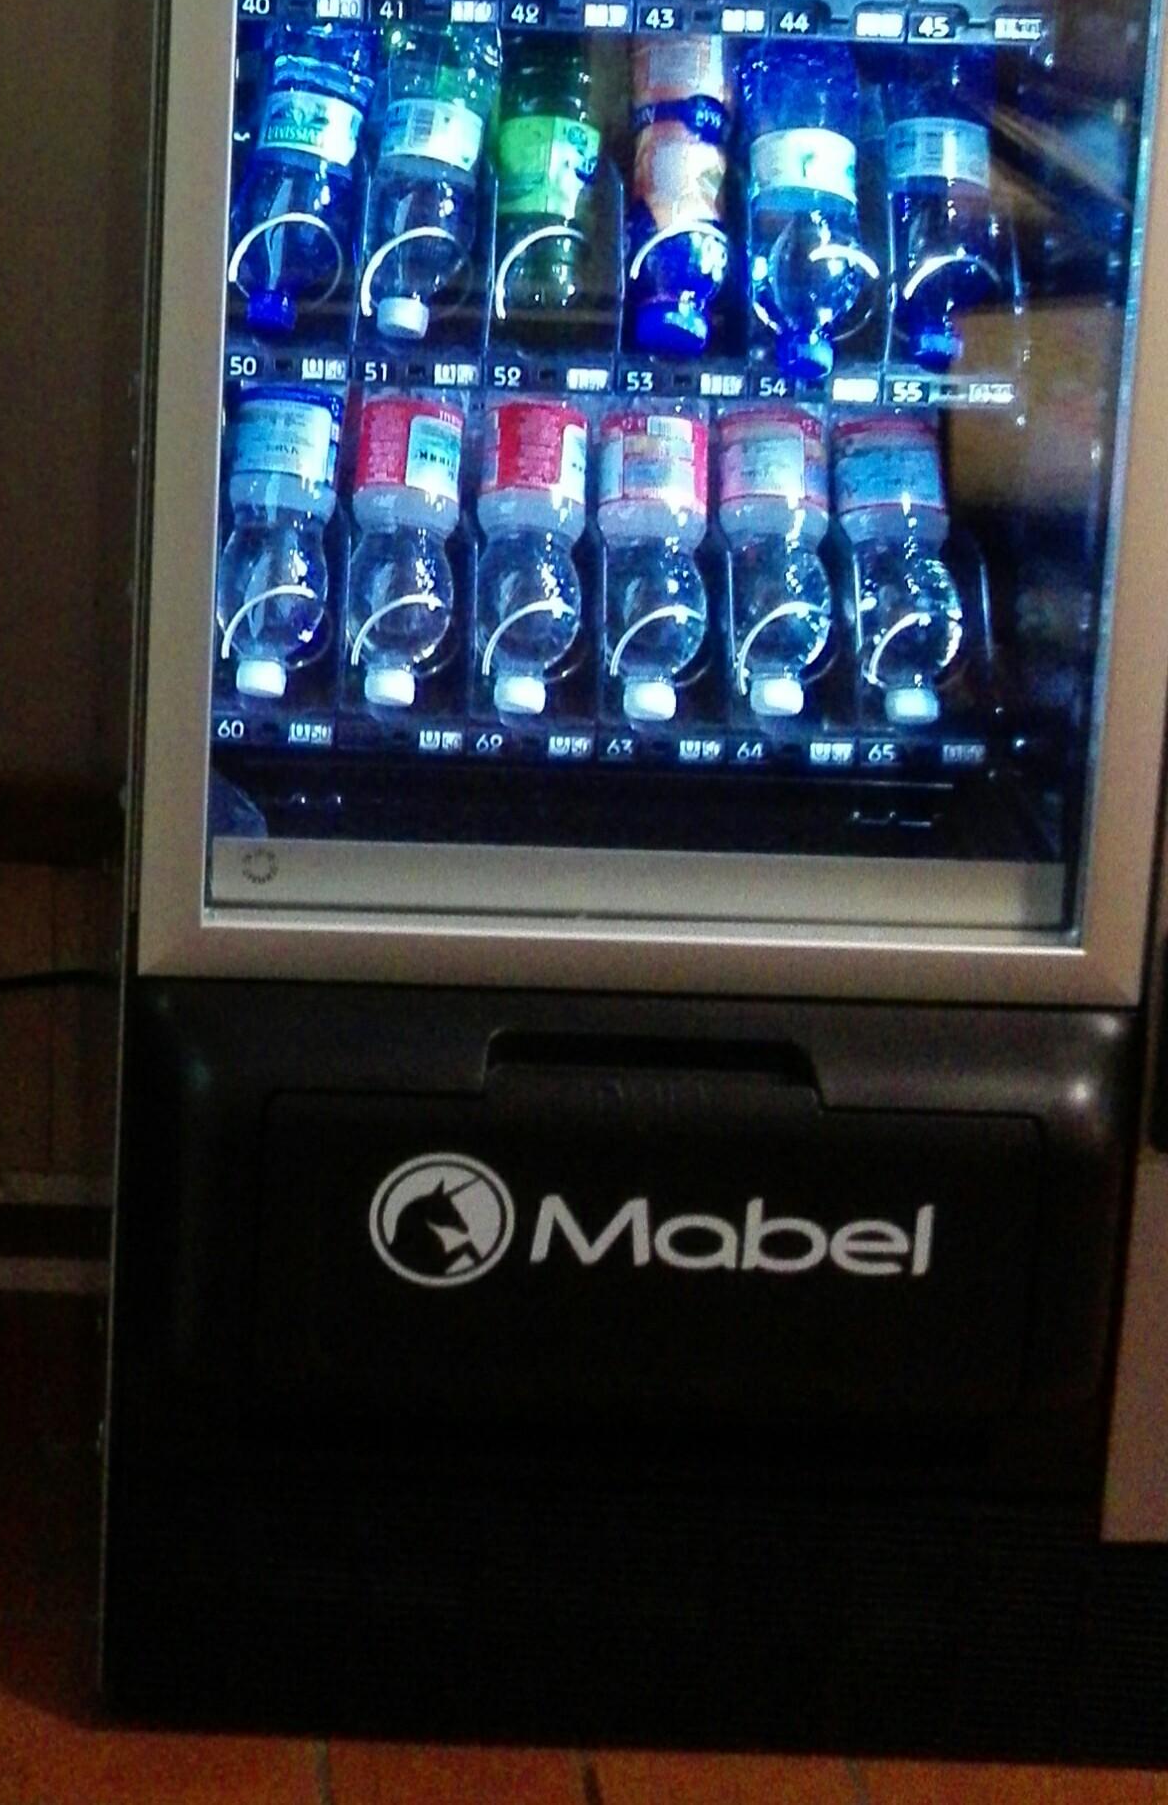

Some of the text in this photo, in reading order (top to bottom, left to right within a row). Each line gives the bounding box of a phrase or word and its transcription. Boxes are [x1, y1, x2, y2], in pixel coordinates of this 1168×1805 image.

[379, 0, 406, 20] 41
[511, 3, 540, 24] 42
[645, 8, 675, 30] 43
[779, 10, 810, 32] 44
[918, 15, 950, 39] 45
[230, 355, 257, 376] 50
[364, 361, 388, 382] 51
[493, 365, 522, 387] 52
[626, 370, 654, 391] 53
[759, 375, 787, 397] 54
[893, 381, 924, 404] 55
[217, 719, 244, 740] 60
[475, 731, 504, 752] 62
[736, 742, 764, 761] 64
[868, 743, 896, 763] 65
[529, 1194, 935, 1277] Mabel
